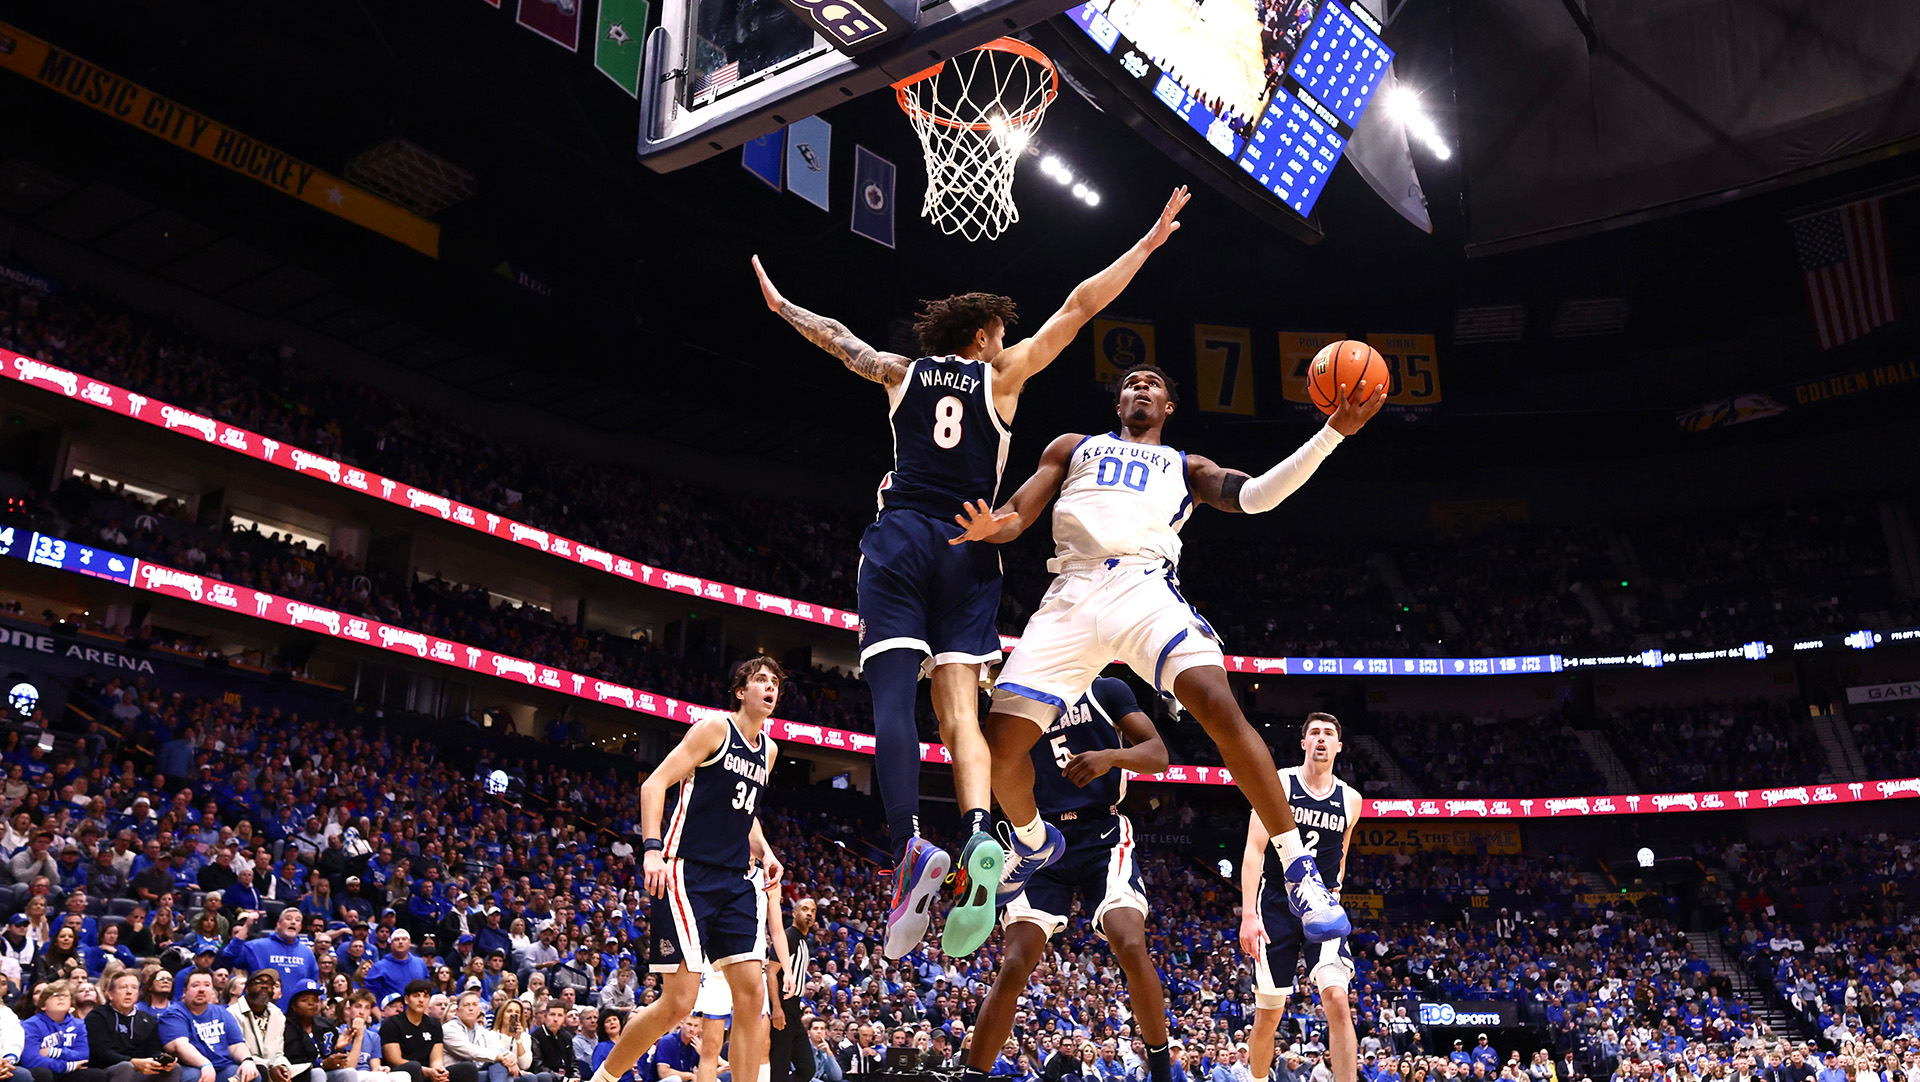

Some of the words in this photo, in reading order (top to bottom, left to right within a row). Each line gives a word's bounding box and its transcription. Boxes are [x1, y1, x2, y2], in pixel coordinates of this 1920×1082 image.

[40, 46, 138, 118] MUSIC
[143, 97, 210, 149] CITY
[212, 128, 315, 196] HOCKEY
[1315, 104, 1339, 128] STATS
[919, 369, 981, 395] WARLEY
[1202, 338, 1242, 410] 7
[1796, 371, 1870, 405] GOLDEN
[933, 395, 964, 450] 8
[1082, 446, 1171, 473] KENTUCKY
[1096, 456, 1149, 491] 00
[36, 536, 66, 561] 33
[66, 644, 154, 675] ARENA
[1303, 659, 1313, 671] 0
[1353, 660, 1364, 672] 4
[1454, 660, 1465, 672] 9
[1049, 734, 1073, 769] 5
[731, 781, 758, 816] 34
[1134, 833, 1157, 843] UITE
[1304, 830, 1320, 858] 2
[1360, 829, 1421, 848] 102.5
[1422, 833, 1449, 844] THE
[1456, 1013, 1501, 1025] SPORTS
